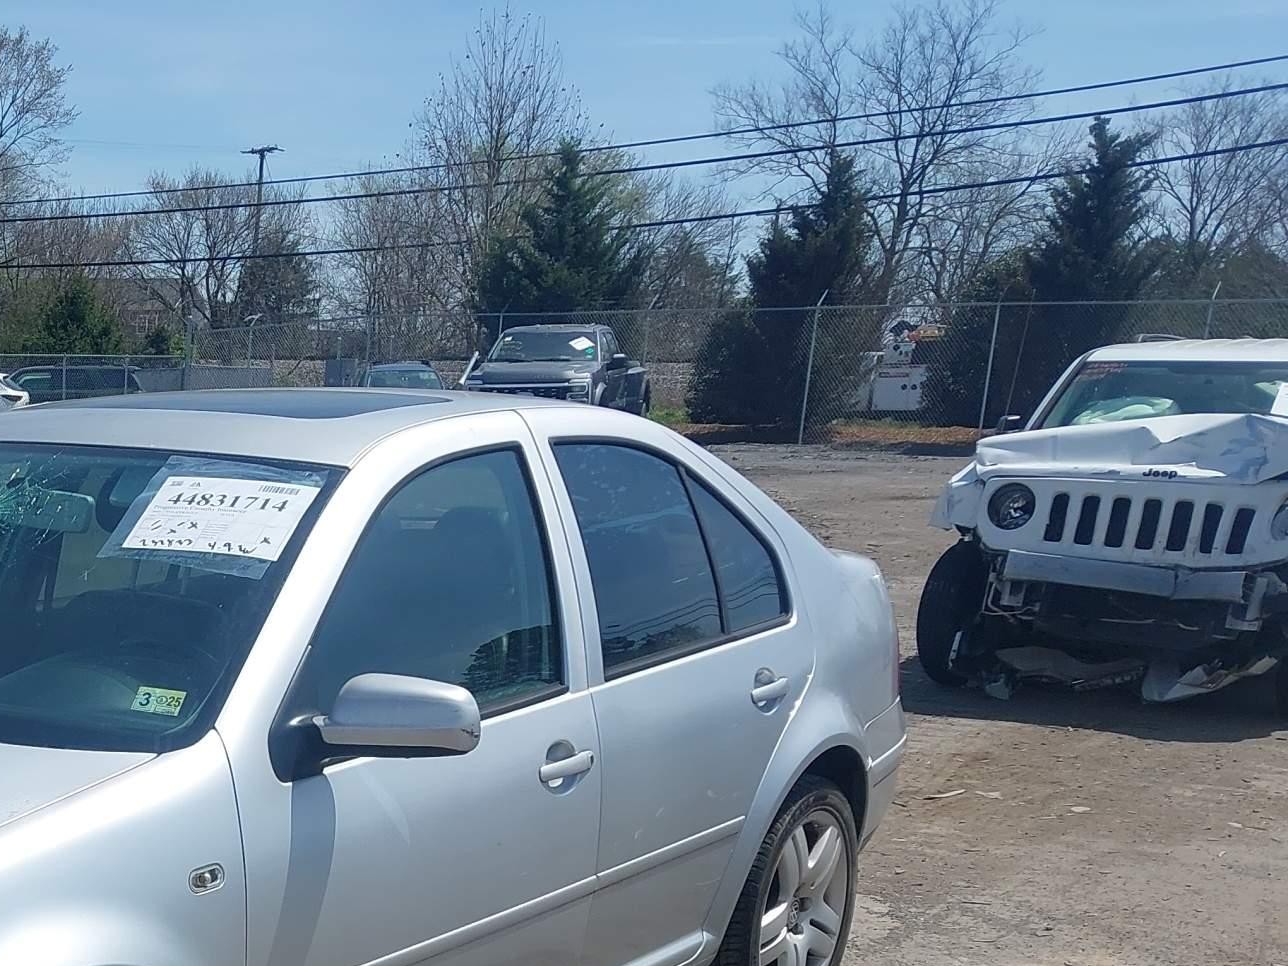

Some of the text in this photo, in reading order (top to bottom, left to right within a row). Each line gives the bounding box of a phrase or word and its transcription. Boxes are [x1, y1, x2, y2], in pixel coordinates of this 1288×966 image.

[1142, 468, 1178, 480] Jeep
[167, 491, 290, 513] 44831714
[138, 692, 183, 708] 3 25
